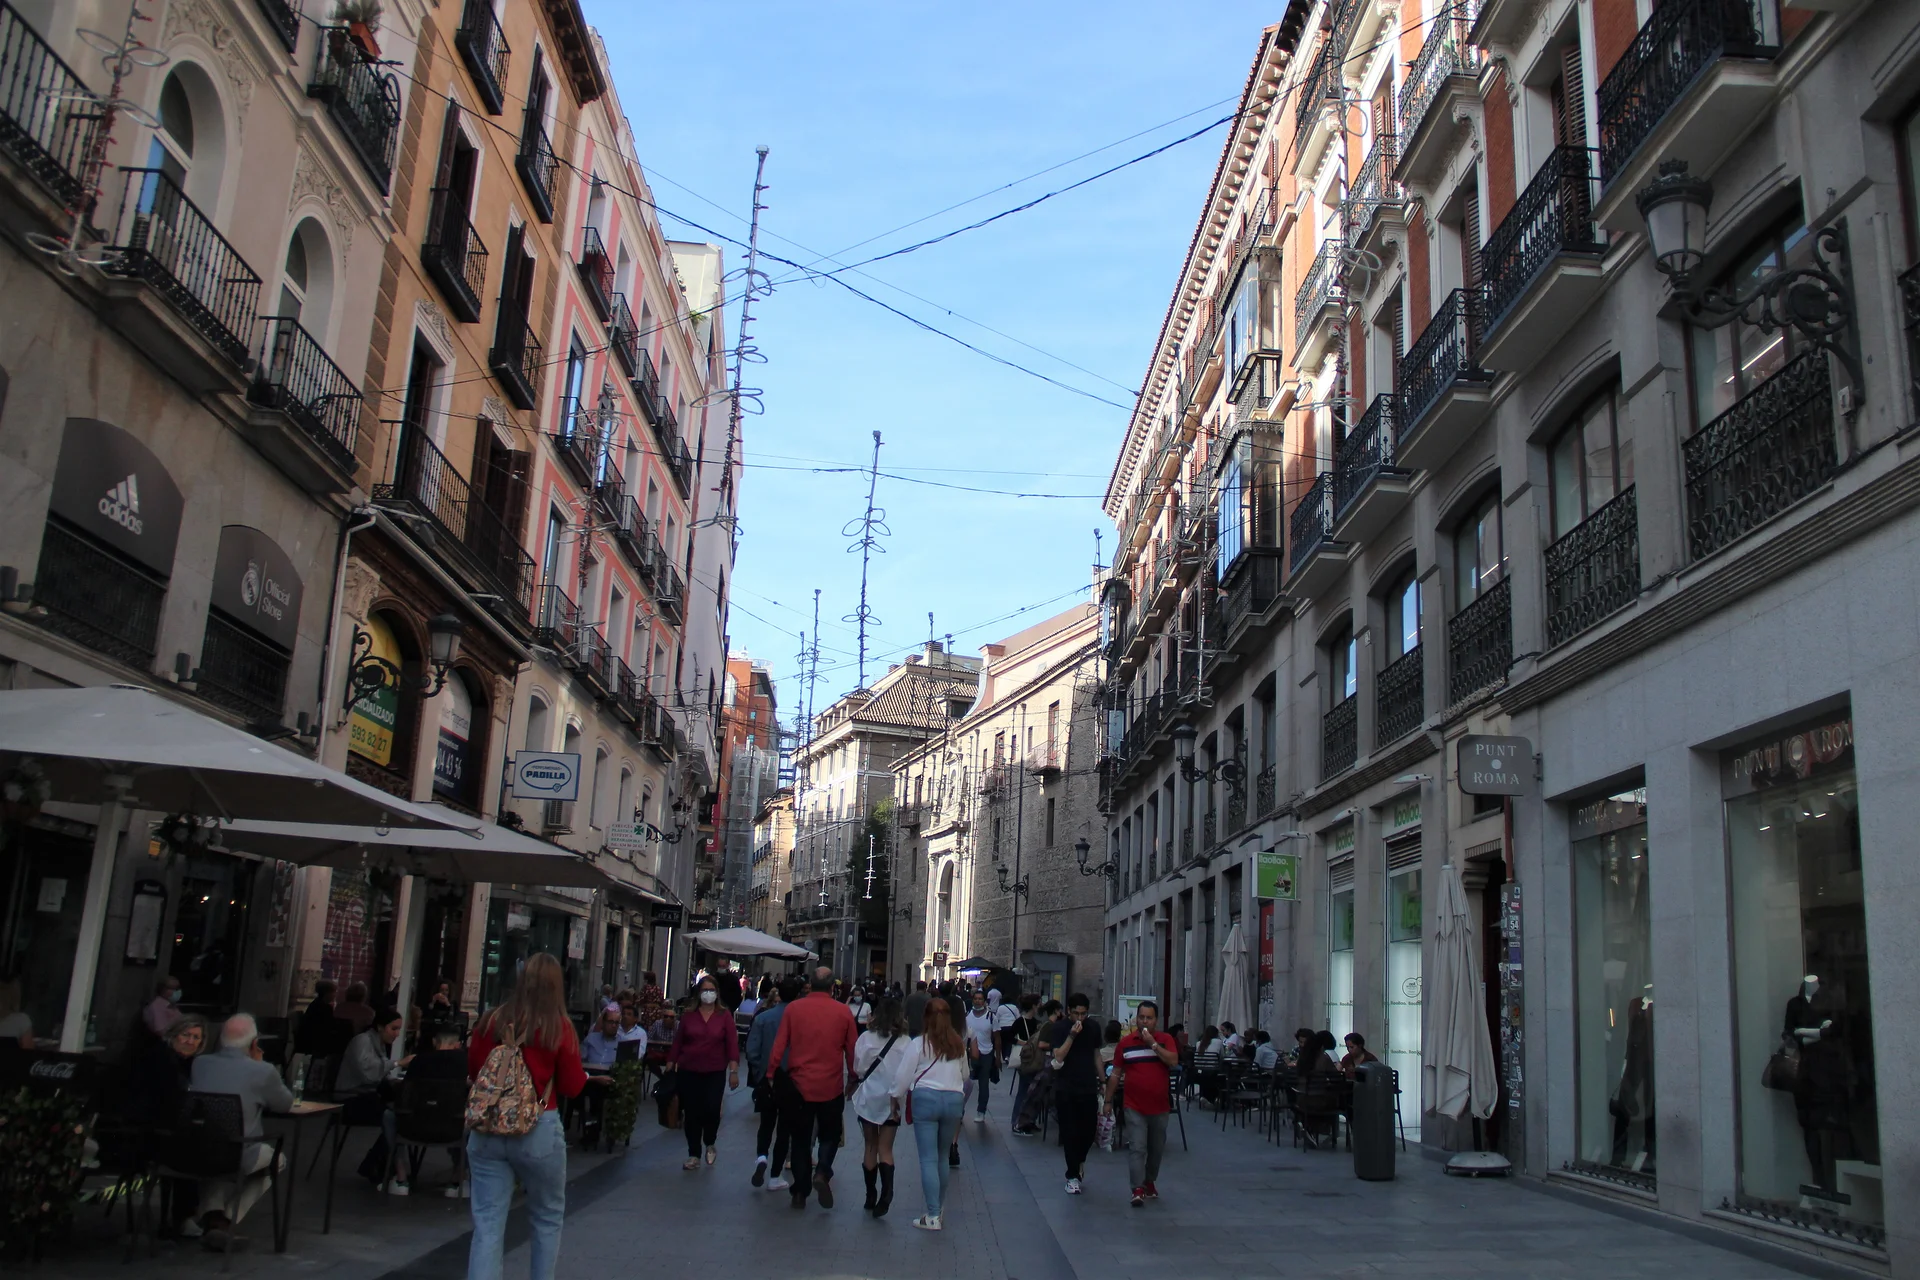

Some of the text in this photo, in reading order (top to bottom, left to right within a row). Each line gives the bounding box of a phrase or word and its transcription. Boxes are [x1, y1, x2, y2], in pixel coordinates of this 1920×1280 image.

[98, 497, 142, 535] adidas
[265, 578, 291, 606] Official
[262, 597, 282, 621] Store
[351, 724, 366, 743] 593
[367, 731, 377, 748] 82
[377, 737, 388, 752] 27
[1475, 743, 1517, 757] PUNT
[525, 770, 566, 780] PADILLA
[1734, 747, 1778, 779] PUNT
[1473, 771, 1520, 785] ROMA
[1258, 854, 1289, 866] llaollao.
